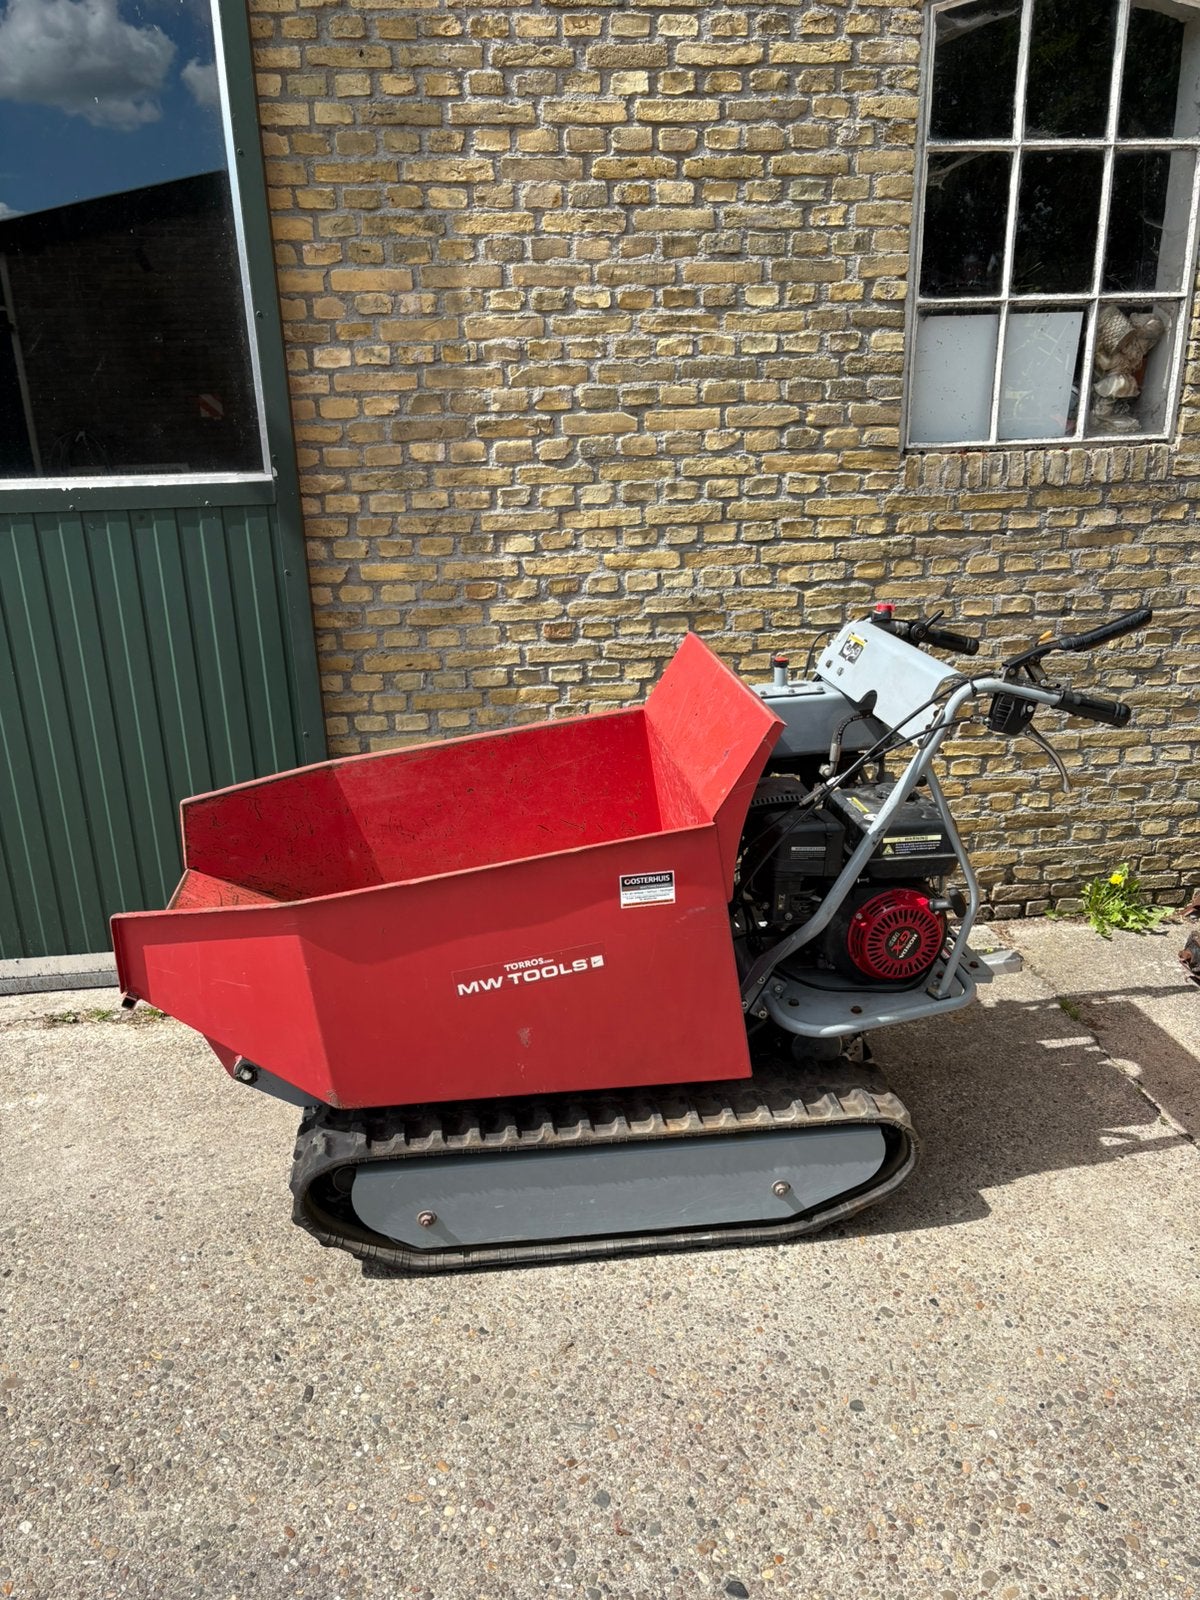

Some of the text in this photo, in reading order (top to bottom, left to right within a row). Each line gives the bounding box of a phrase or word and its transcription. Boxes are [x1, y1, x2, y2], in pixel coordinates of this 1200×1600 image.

[624, 875, 670, 885] OOSTERHUIS
[890, 930, 911, 956] GX
[898, 933, 919, 959] HONDA
[457, 959, 588, 996] MW TOOLS
